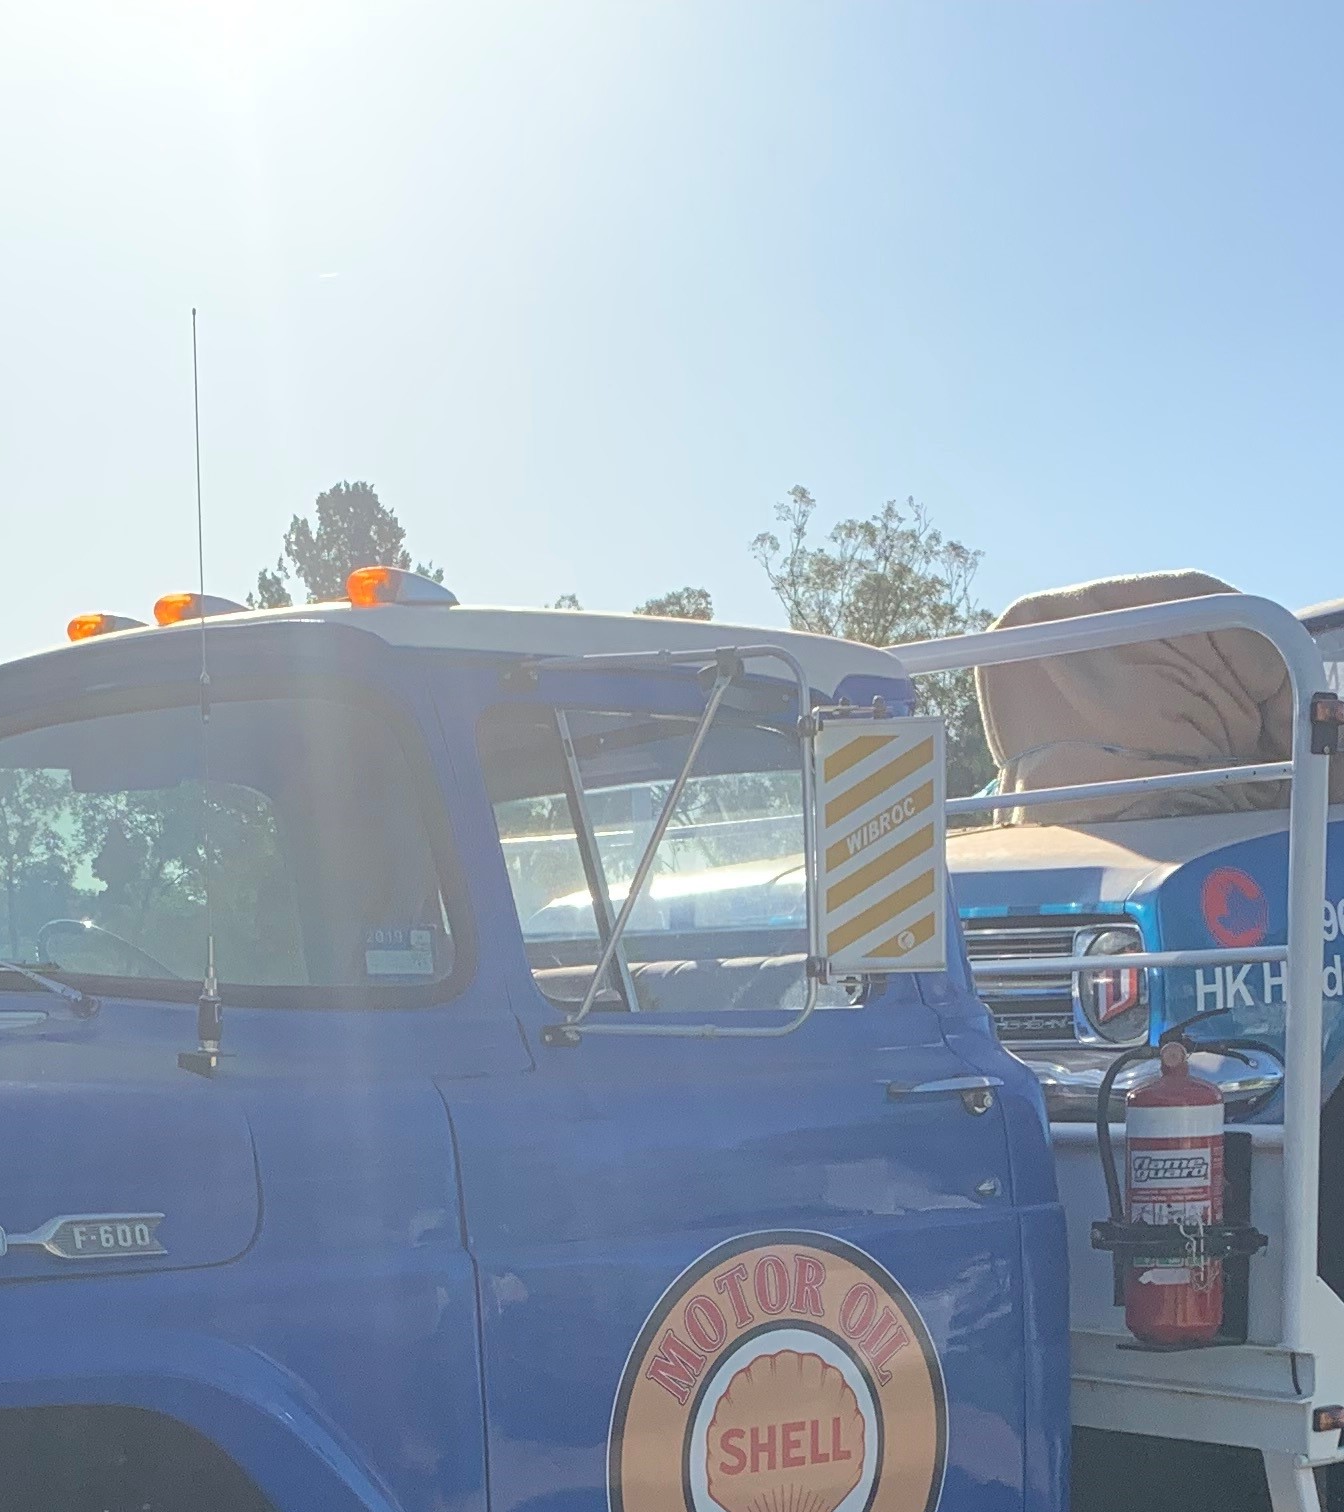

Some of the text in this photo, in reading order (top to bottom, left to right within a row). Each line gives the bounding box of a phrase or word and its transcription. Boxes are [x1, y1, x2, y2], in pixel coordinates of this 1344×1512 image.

[845, 797, 916, 855] WIBROC
[1196, 964, 1254, 1011] HK
[1134, 1156, 1206, 1169] flame
[1135, 1164, 1208, 1182] guard
[73, 1224, 151, 1249] F-600
[646, 1254, 909, 1405] MOTOR OIL
[720, 1417, 852, 1476] SHELL
